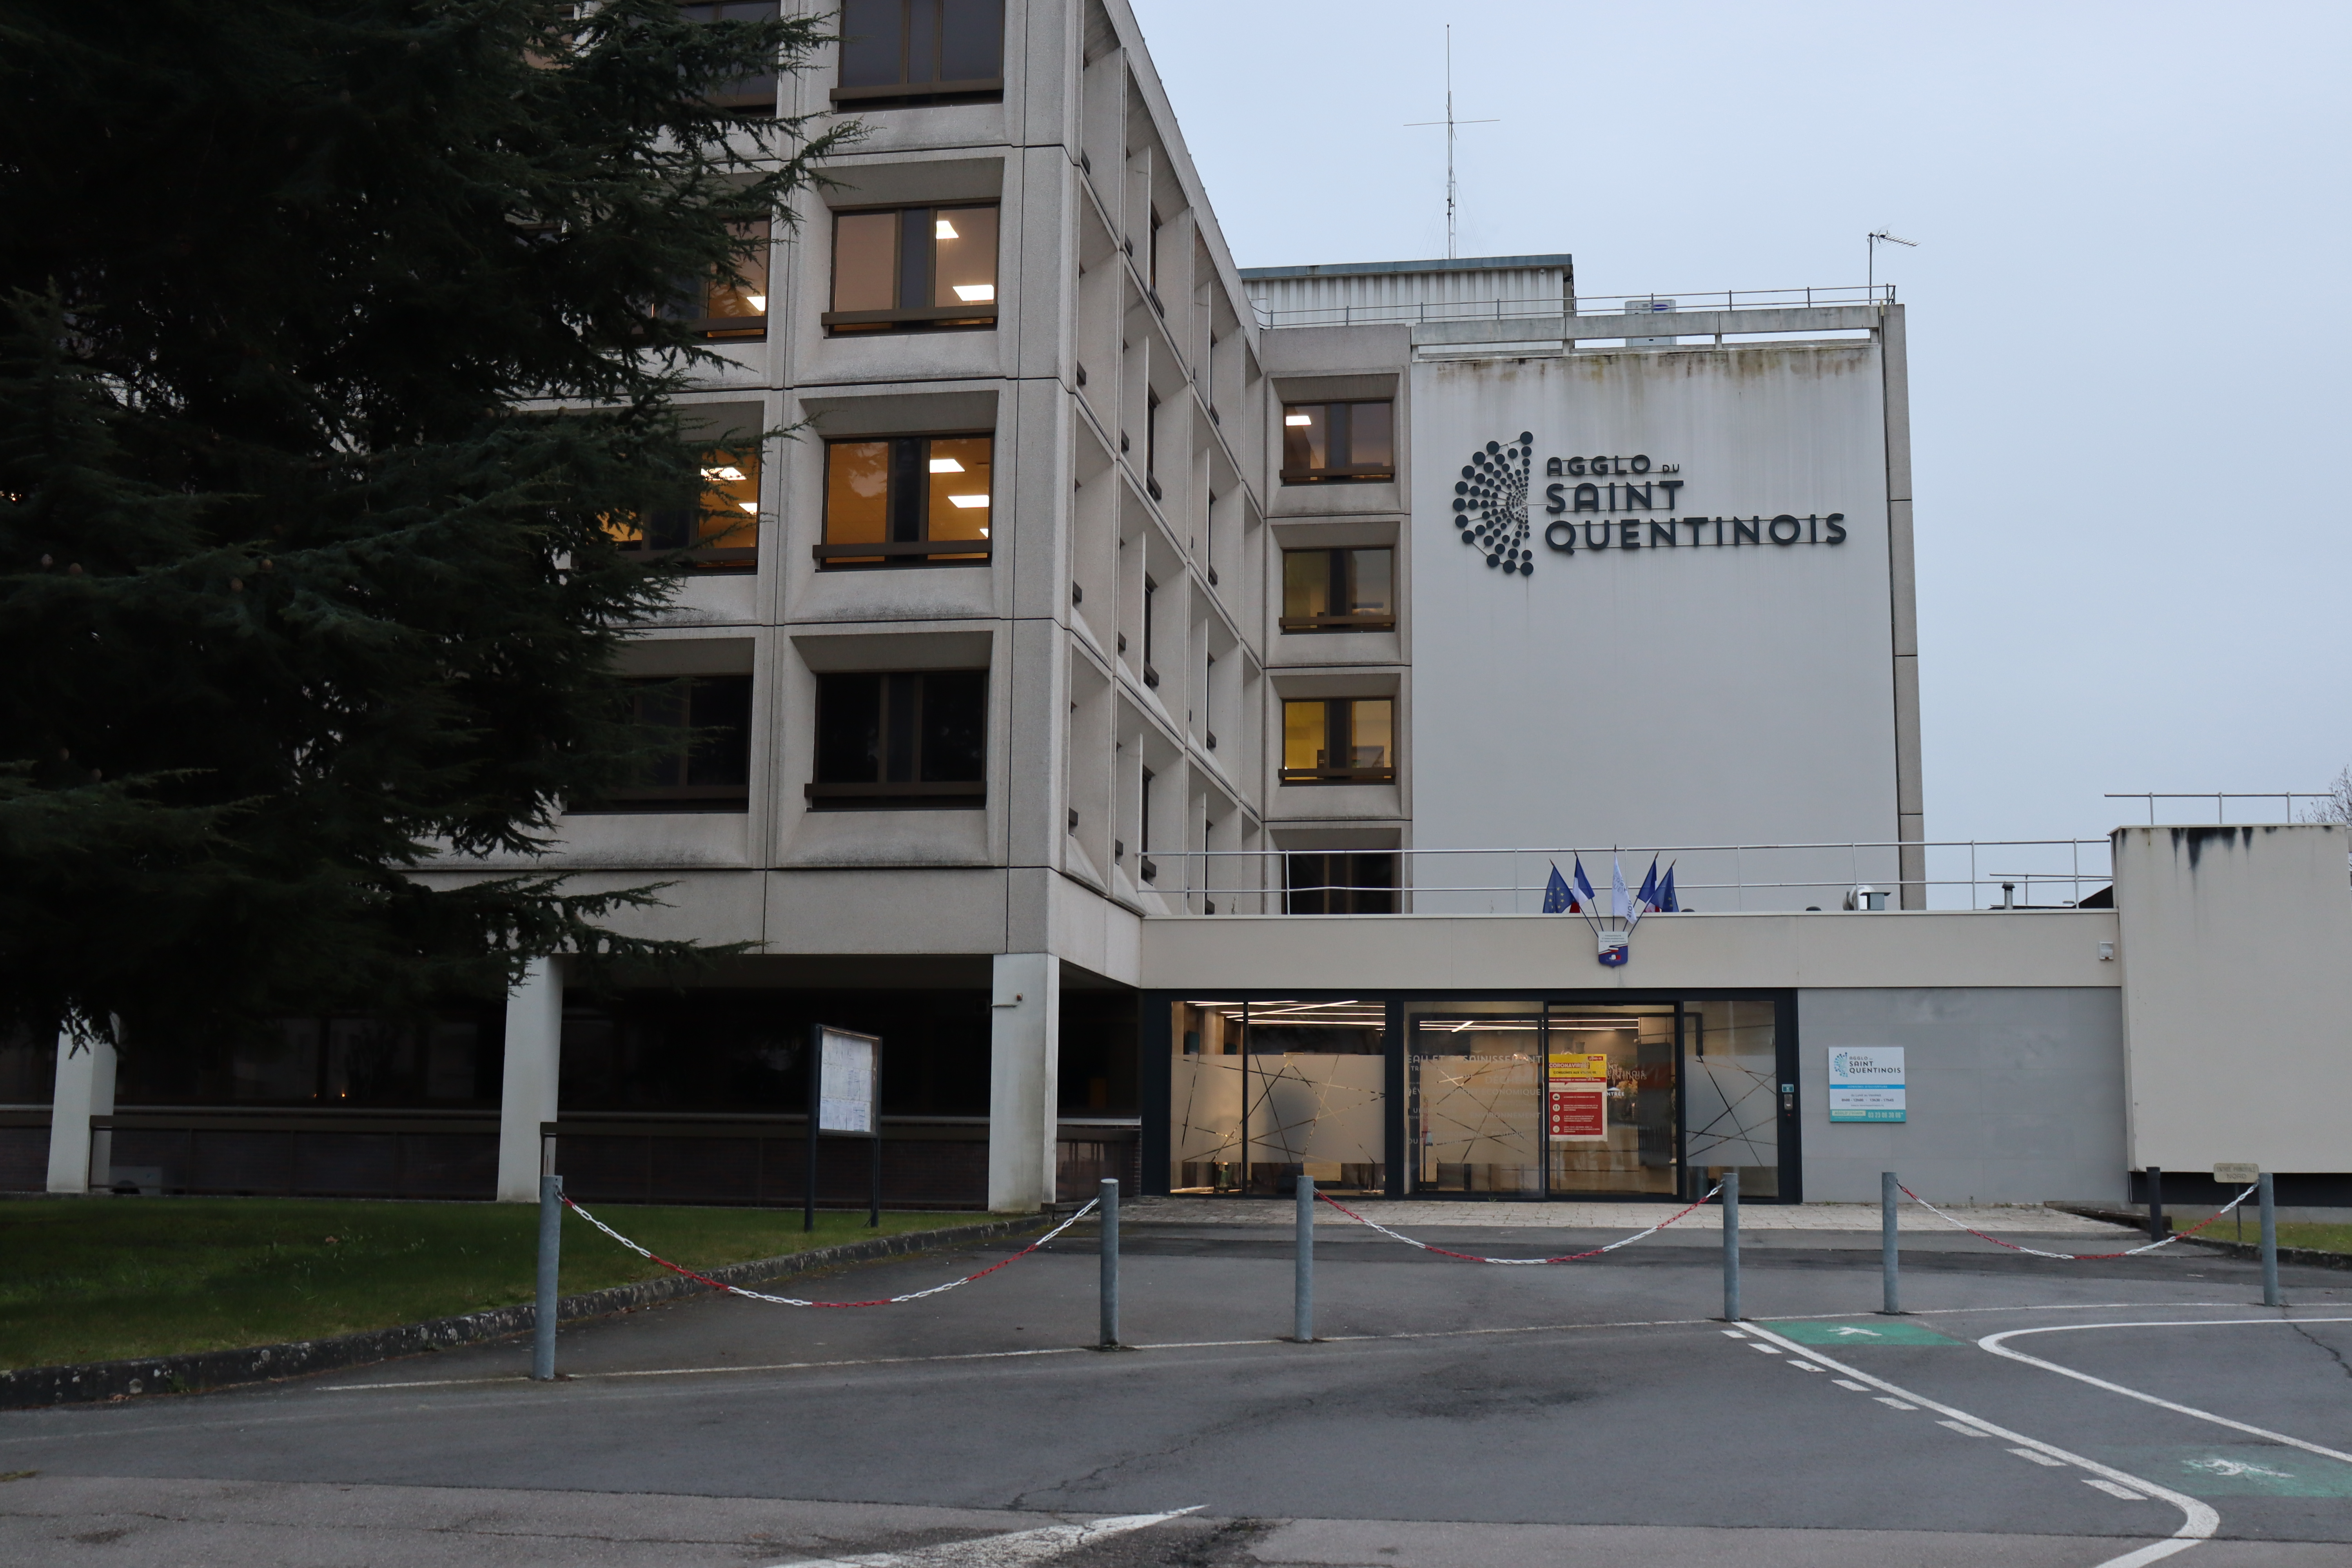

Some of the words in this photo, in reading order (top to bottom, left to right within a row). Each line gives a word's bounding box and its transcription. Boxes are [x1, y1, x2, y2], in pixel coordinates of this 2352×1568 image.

[1547, 454, 1651, 476] AGGLO
[1662, 463, 1680, 473] DU
[1546, 480, 1684, 513] SAINT
[1545, 513, 1847, 555] QUENTINOIS
